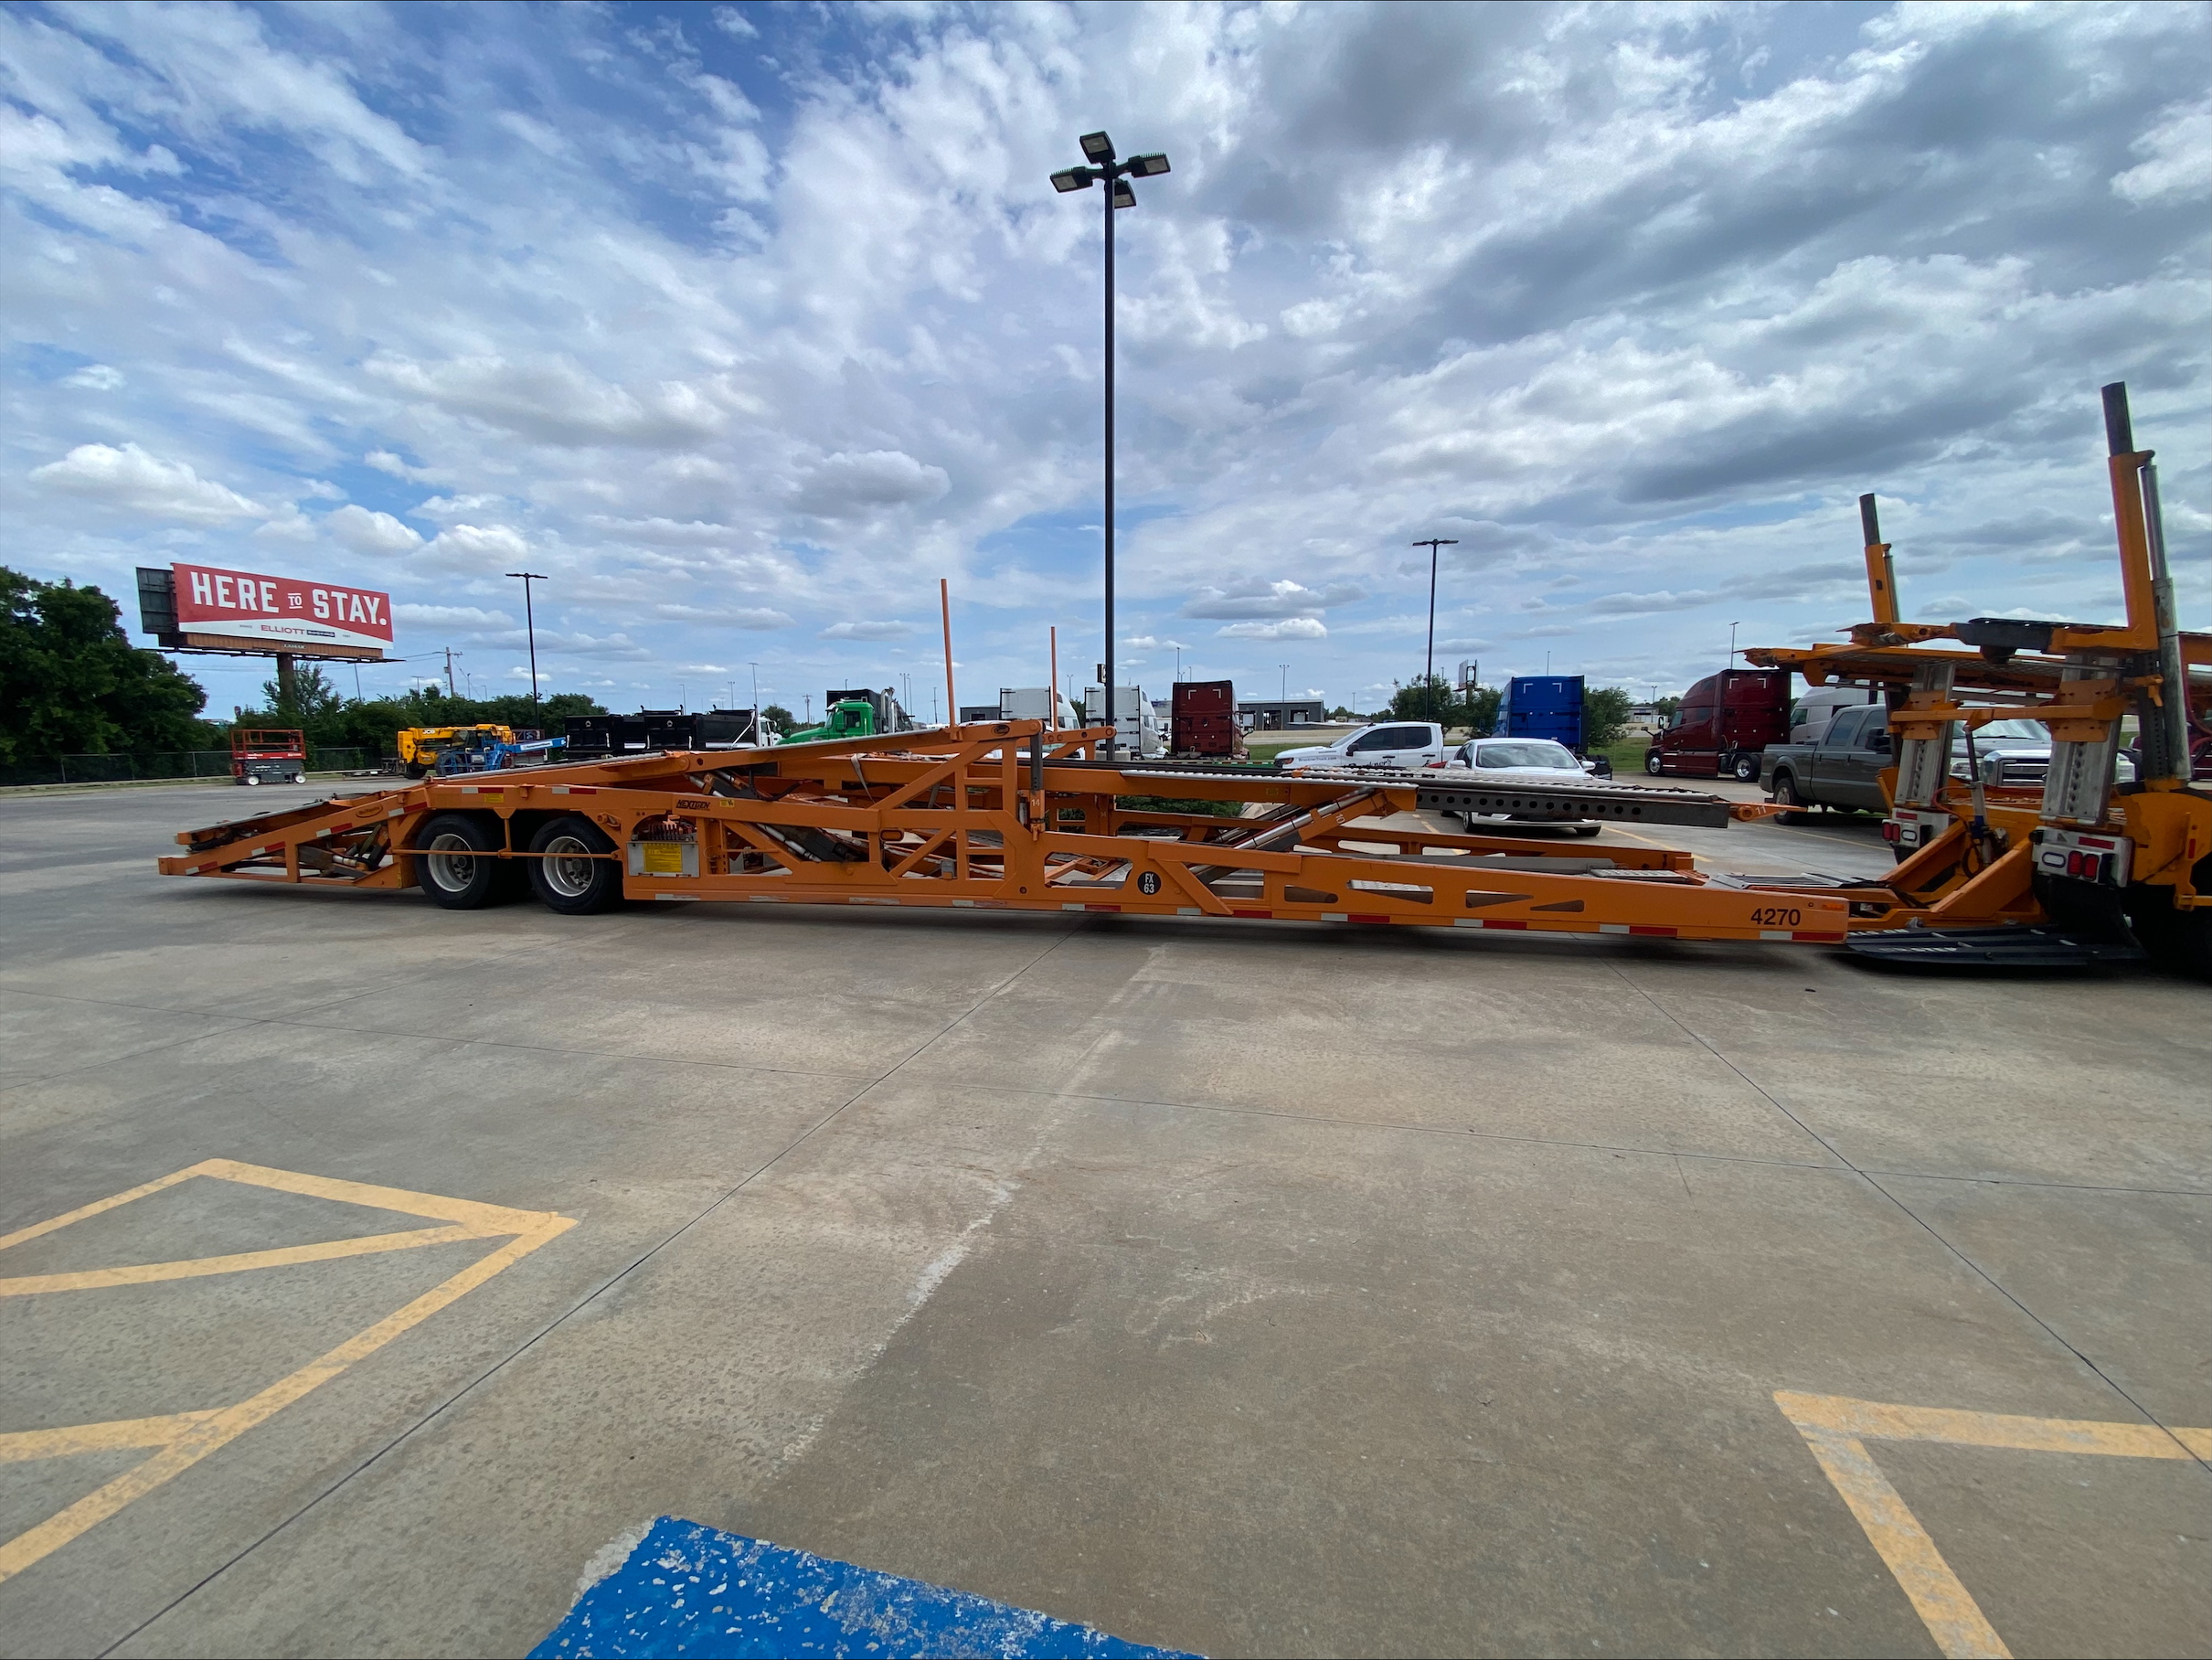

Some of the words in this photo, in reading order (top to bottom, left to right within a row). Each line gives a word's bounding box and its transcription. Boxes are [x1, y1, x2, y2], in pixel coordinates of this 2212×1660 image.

[190, 571, 279, 613] HERE
[288, 595, 303, 607] TO
[312, 589, 387, 626] STAY.
[261, 624, 305, 635] ELLIOTT
[675, 799, 710, 811] NEXTGEN
[1031, 798, 1040, 807] 14
[1755, 805, 1767, 815] 11
[1335, 814, 1345, 824] 10
[1144, 873, 1154, 883] FX
[1143, 883, 1154, 894] 63
[1750, 908, 1801, 926] 4270
